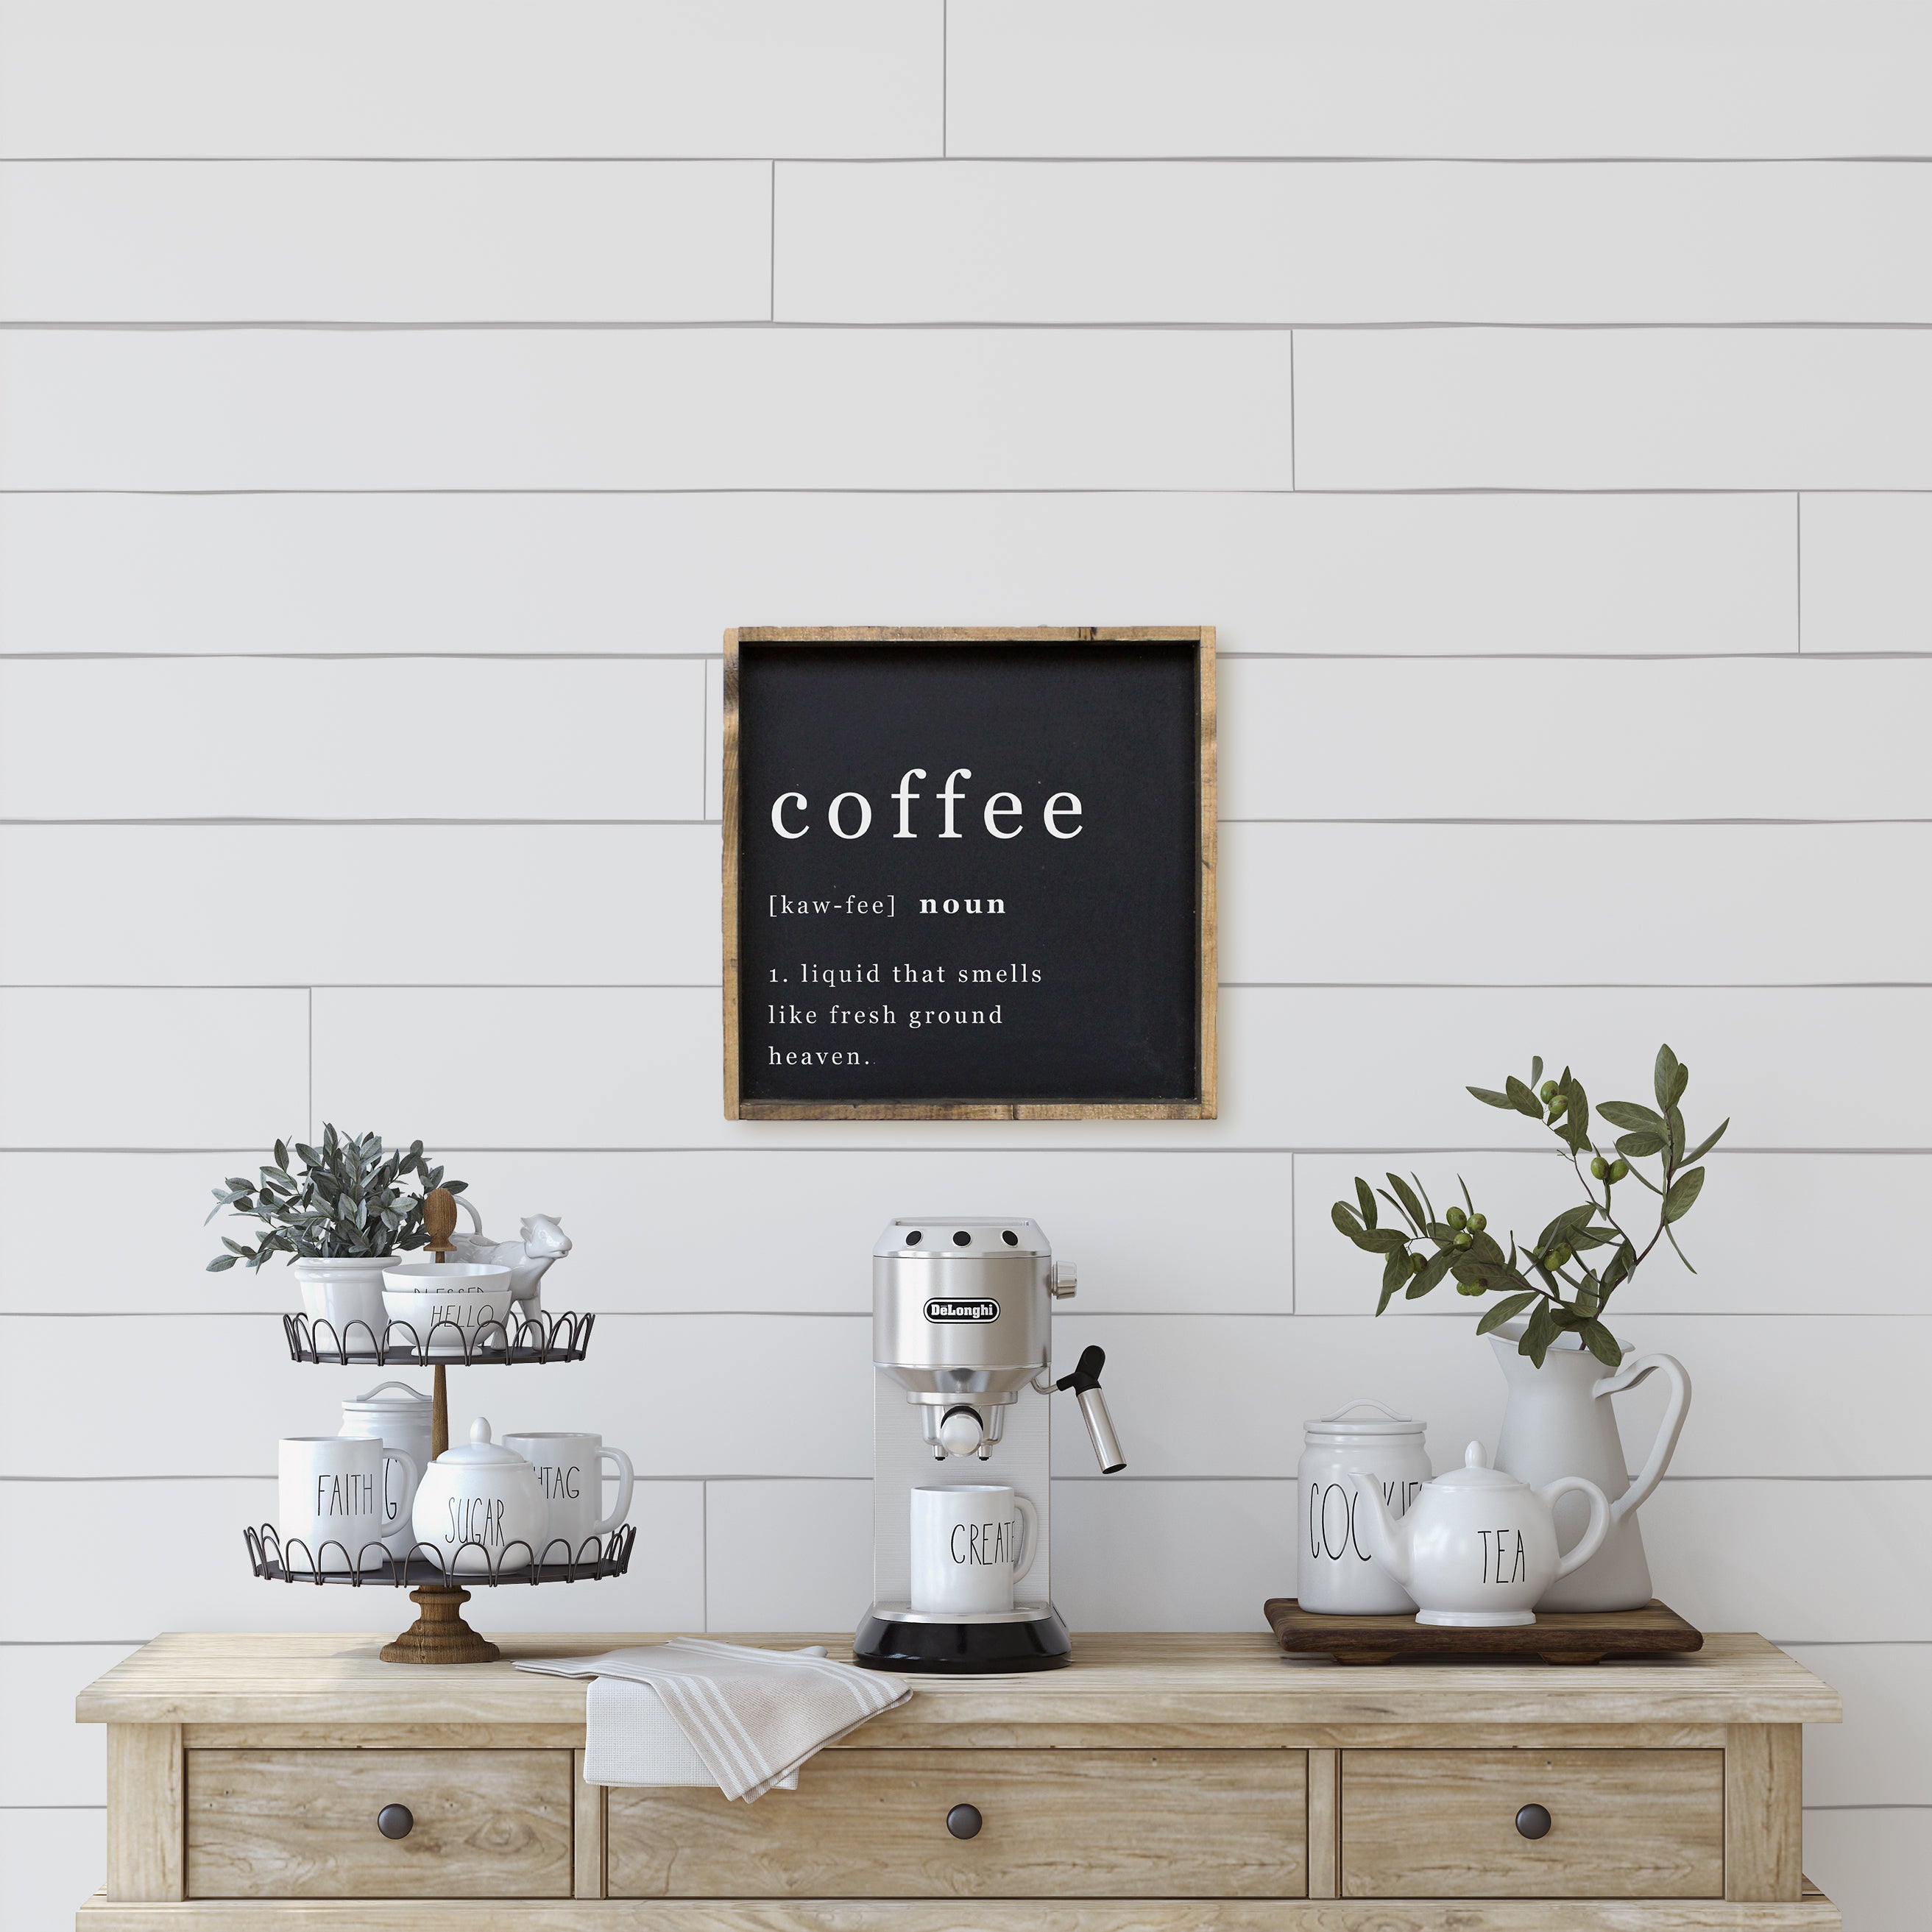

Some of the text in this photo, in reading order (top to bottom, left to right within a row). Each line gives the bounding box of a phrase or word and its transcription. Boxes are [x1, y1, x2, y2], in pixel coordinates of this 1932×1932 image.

[771, 768, 1083, 840] coffee
[769, 894, 1006, 917] [kaw-fee] noun
[769, 963, 1041, 988] 1. liquid that smells
[768, 1005, 1002, 1029] like fresh ground
[768, 1046, 870, 1065] heaven.
[431, 1304, 494, 1328] HELLO
[317, 1473, 372, 1516] FAITH
[445, 1496, 505, 1547] SUGAR
[950, 1521, 1015, 1565] CREATE
[1477, 1529, 1525, 1584] TEA
